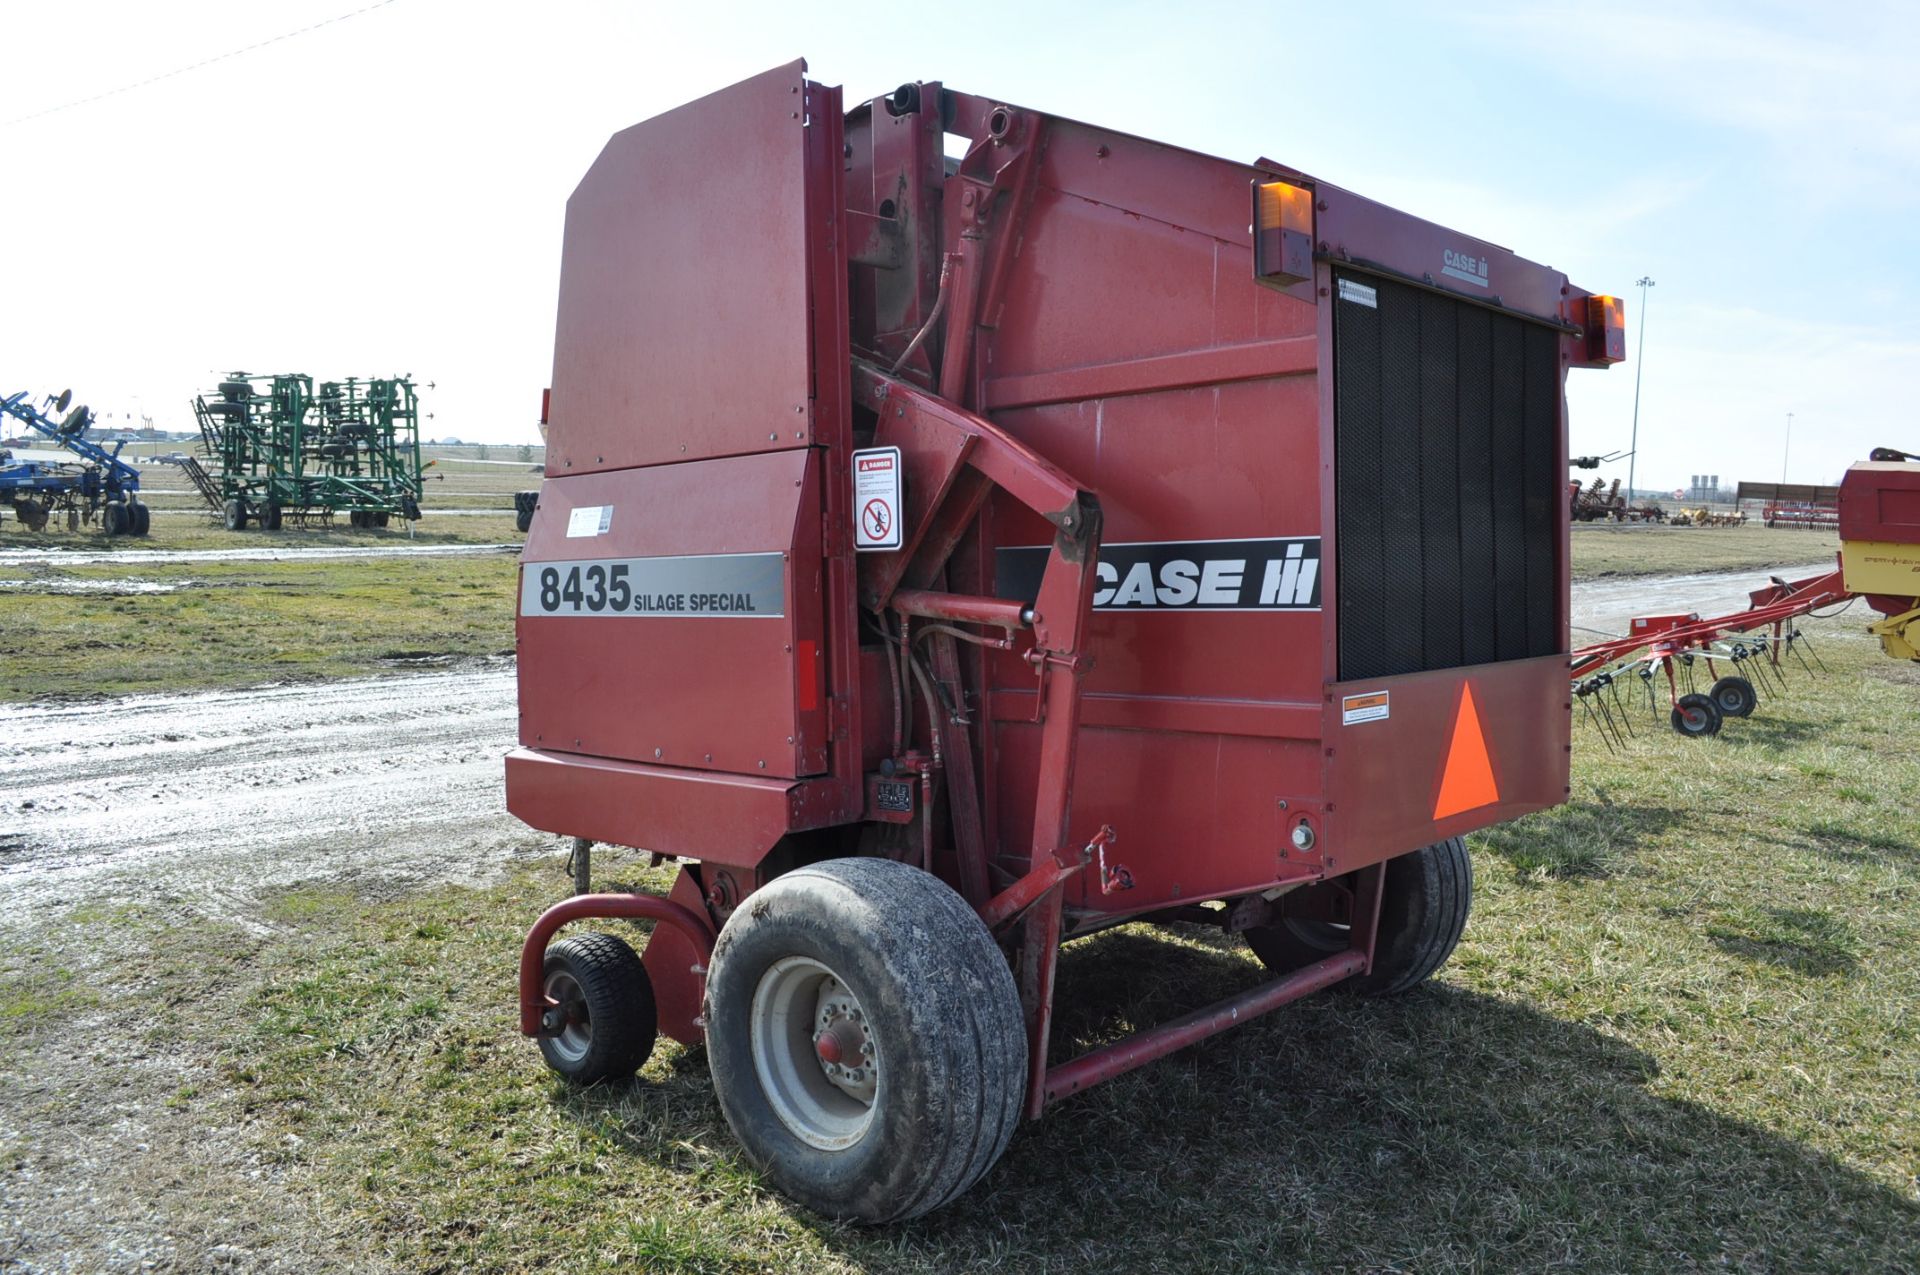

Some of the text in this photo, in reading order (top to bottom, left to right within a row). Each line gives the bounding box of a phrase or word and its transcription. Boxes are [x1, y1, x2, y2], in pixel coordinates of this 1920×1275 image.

[1443, 249, 1476, 274] CASE
[869, 460, 891, 468] DANGER
[540, 564, 756, 612] 8435 SILAGE SPECIAL
[1092, 559, 1247, 606] CASE
